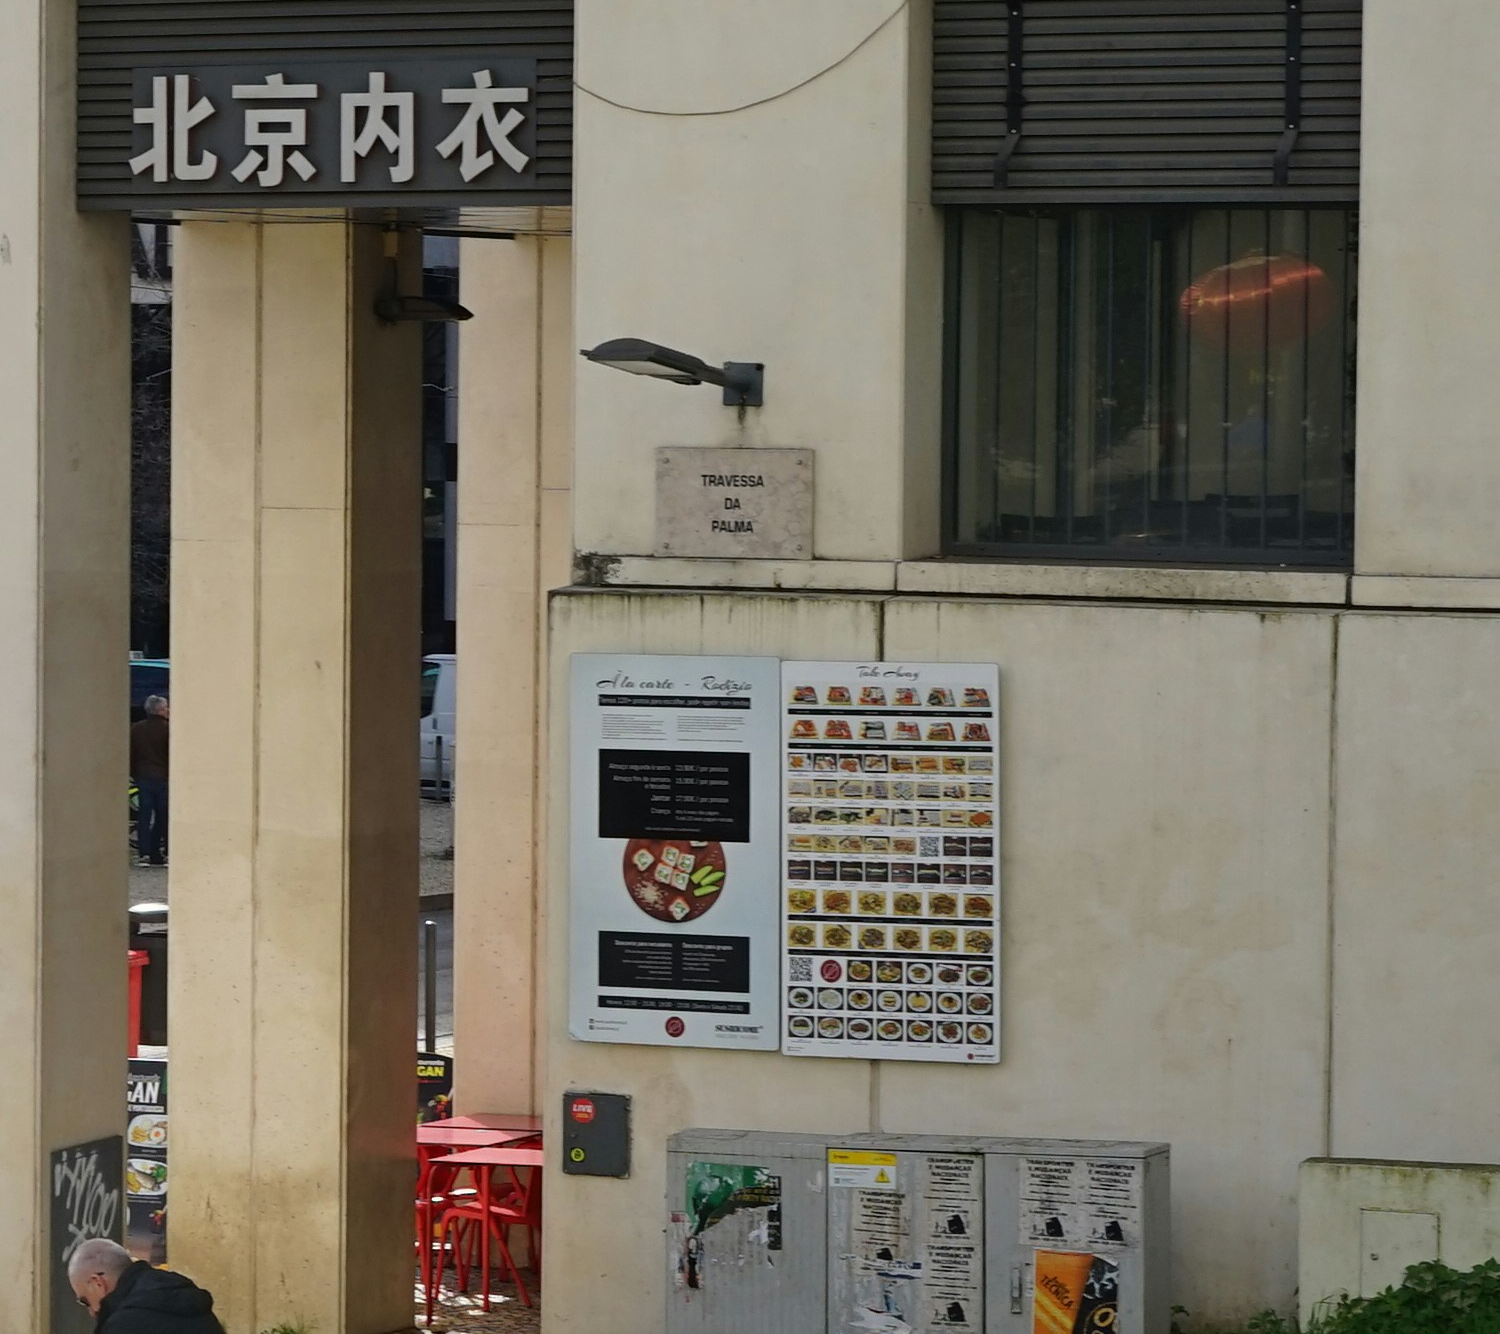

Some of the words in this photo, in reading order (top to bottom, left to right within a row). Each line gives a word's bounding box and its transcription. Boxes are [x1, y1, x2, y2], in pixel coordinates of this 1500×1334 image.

[128, 69, 530, 187] 北京内衣
[701, 474, 764, 488] TRAVESSA
[724, 497, 742, 510] DA
[711, 520, 754, 533] PALMA
